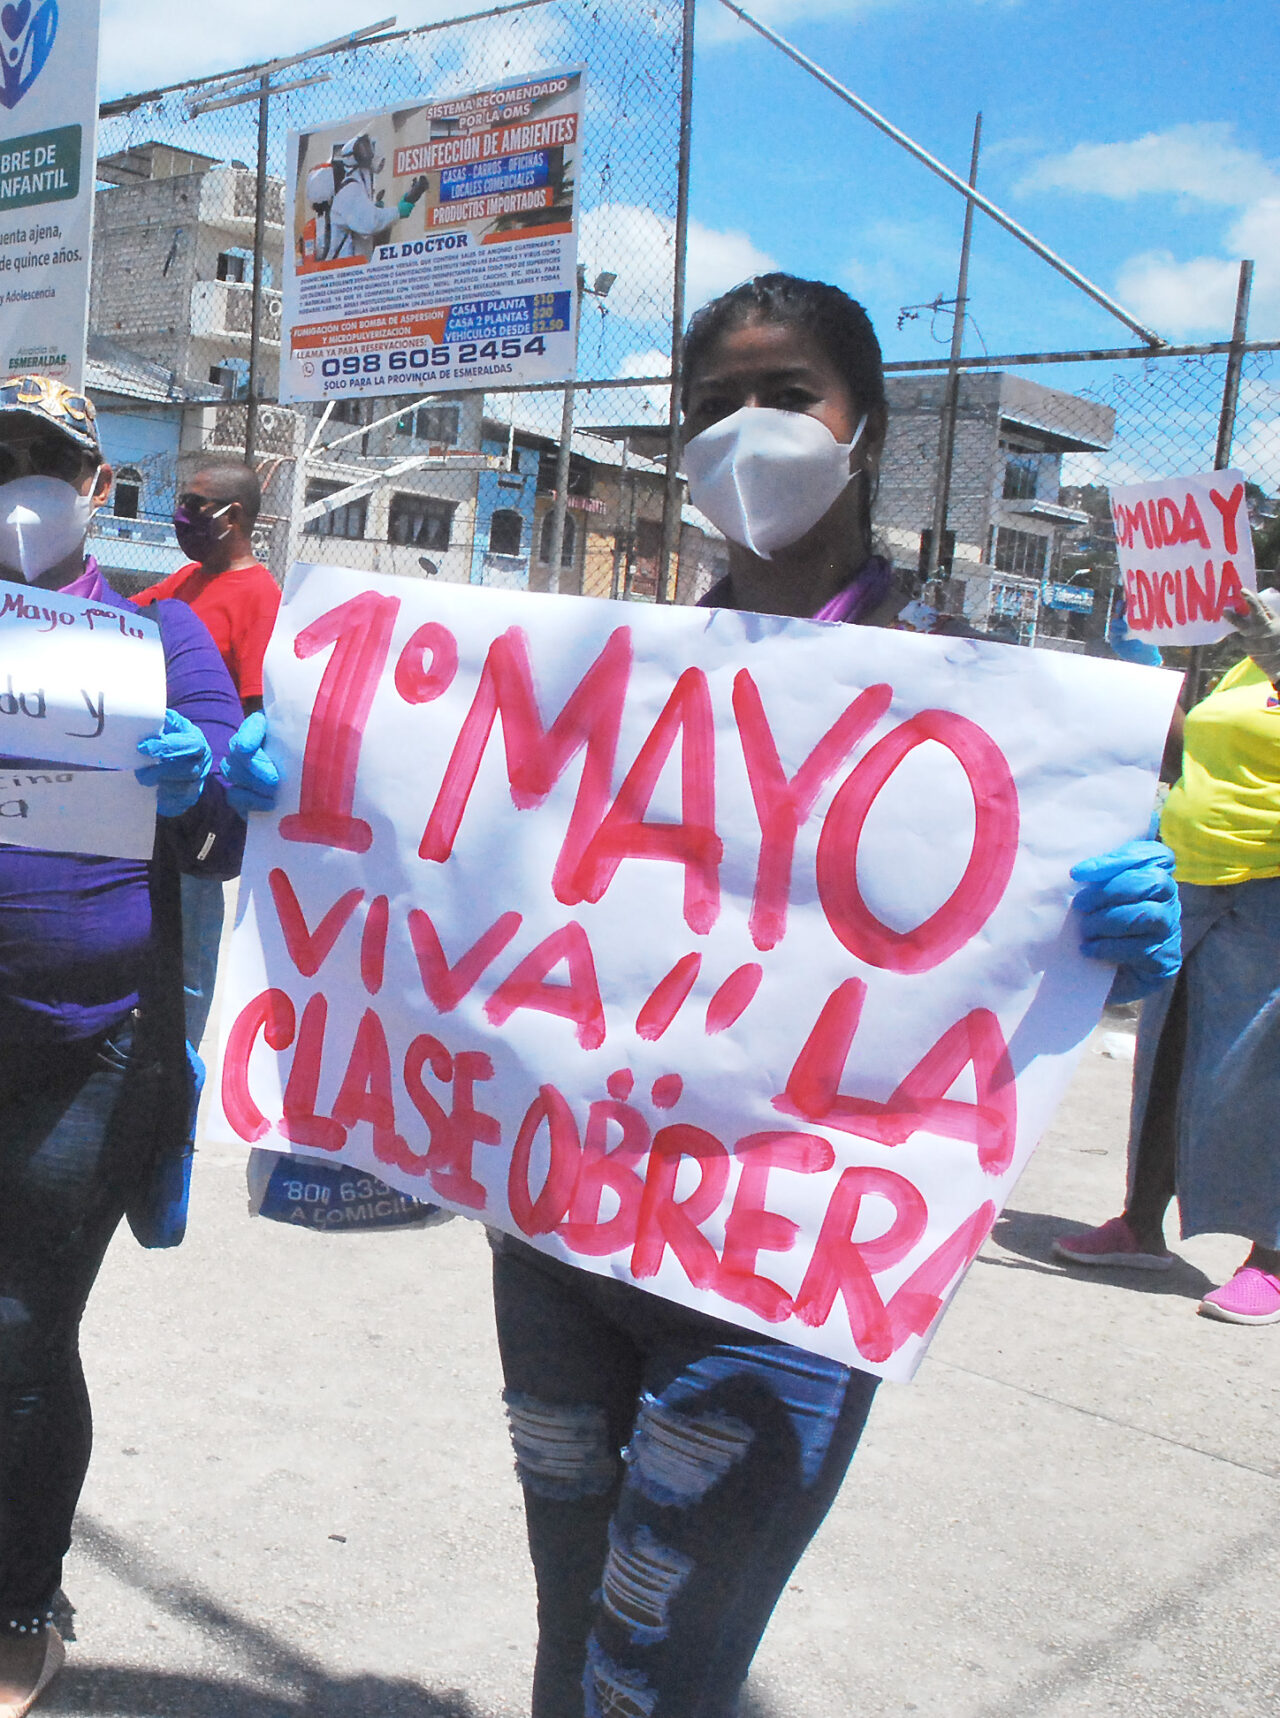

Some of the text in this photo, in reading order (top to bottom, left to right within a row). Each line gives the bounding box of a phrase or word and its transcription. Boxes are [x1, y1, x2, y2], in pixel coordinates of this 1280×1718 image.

[427, 79, 568, 119] SISTEMA RECOMENDADO
[459, 103, 530, 129] POR LA OMS
[34, 144, 56, 167] DE
[397, 117, 575, 173] DESINFECCIÓN DE AMBIENTES
[443, 168, 467, 184] CASAS
[473, 160, 502, 178] CARROS
[509, 152, 544, 171] OFICINAS
[451, 171, 535, 199] LOCALES COMERCIALES
[433, 190, 546, 225] PRODUCTOS IMPORTADOS
[29, 224, 62, 245] ajena,
[380, 234, 468, 260] EL DOCTOR
[13, 252, 50, 273] quince
[52, 247, 82, 265] años.
[5, 286, 56, 304] Adolescencia
[451, 293, 555, 316] CASA 1 PLANTA $10
[294, 310, 444, 337] FUMIGACIÓN CON BOMBA DE ASPERSIÓN
[448, 307, 554, 329] CASA 2 PLANTAS $20
[444, 326, 497, 342] VEHÍCULOS
[500, 323, 531, 336] DESDE
[9, 354, 67, 369] ESMERALDAS
[297, 338, 427, 359] LLAMA YA PARA RESERVACIONES:
[322, 335, 546, 377] 098 605 2454
[324, 363, 513, 391] SOLO PARA LA PROVINCIA DE ESMERALDAS
[1209, 483, 1244, 555] Y
[419, 624, 1019, 974] MAYO
[772, 976, 1019, 1177] LA
[219, 986, 997, 1365] CLASE OBRERA
